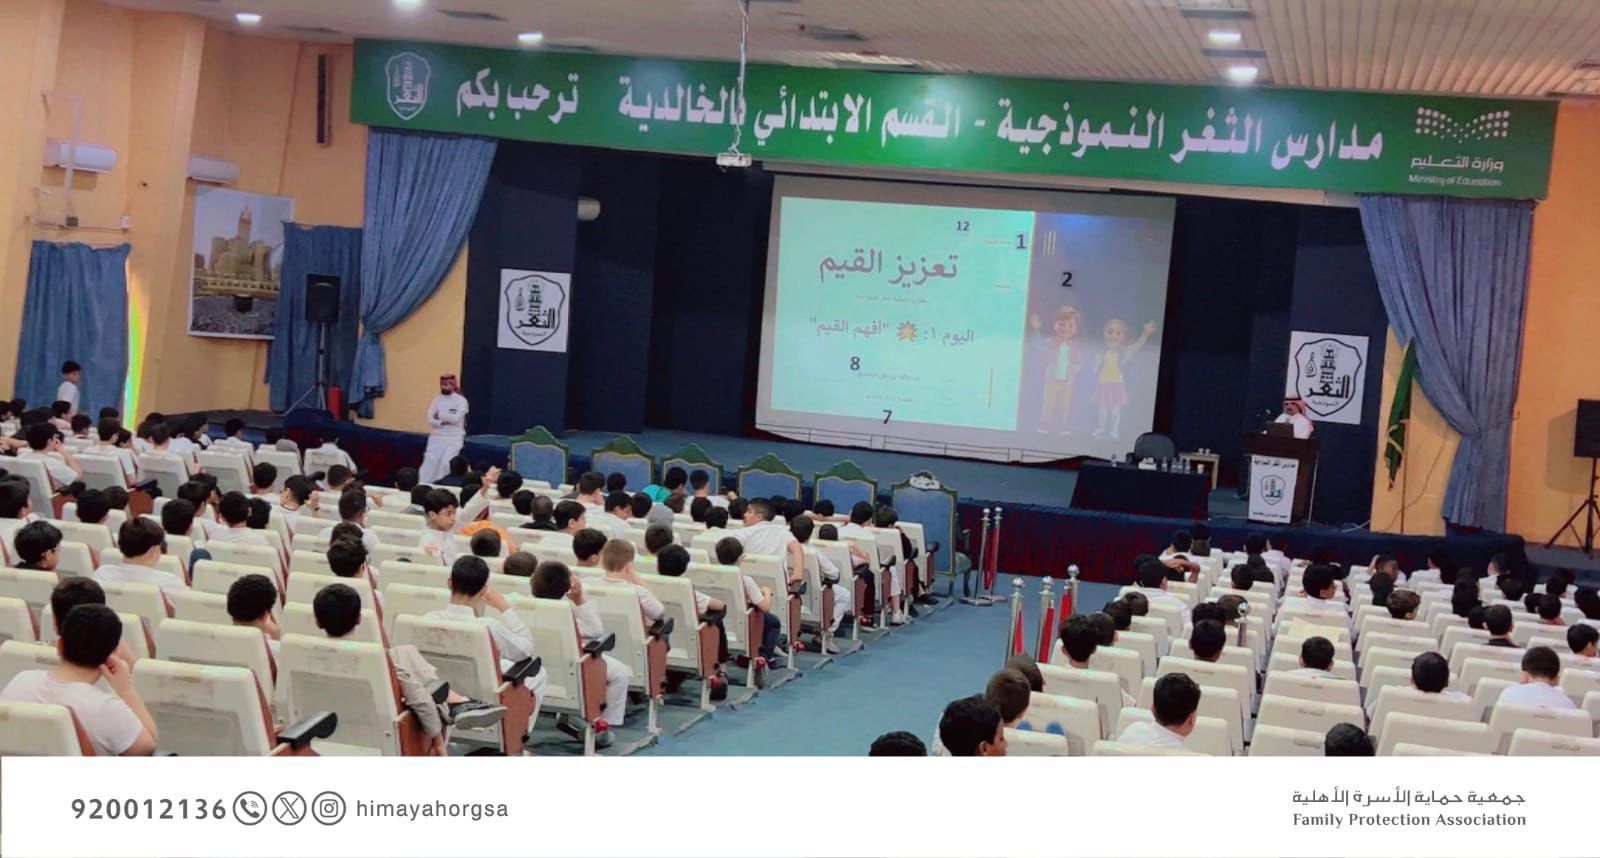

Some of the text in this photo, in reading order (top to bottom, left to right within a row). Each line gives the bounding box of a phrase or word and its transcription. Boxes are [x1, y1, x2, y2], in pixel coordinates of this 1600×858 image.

[456, 67, 499, 120] بكم
[506, 72, 579, 124] ترحب
[753, 85, 872, 147] الابتدائي
[881, 102, 960, 147] القسم
[996, 98, 1165, 159] النموذجية
[1169, 106, 1263, 164] الثغر
[1271, 119, 1384, 170] مدارس
[1411, 155, 1505, 173] وزارة التعليم
[956, 220, 970, 232] 12
[1015, 233, 1027, 250] 1
[818, 247, 959, 289] تعزيز القيم
[1060, 271, 1074, 288] 2
[942, 328, 975, 347] اليوم
[849, 355, 861, 372] 8
[882, 409, 893, 425] 7
